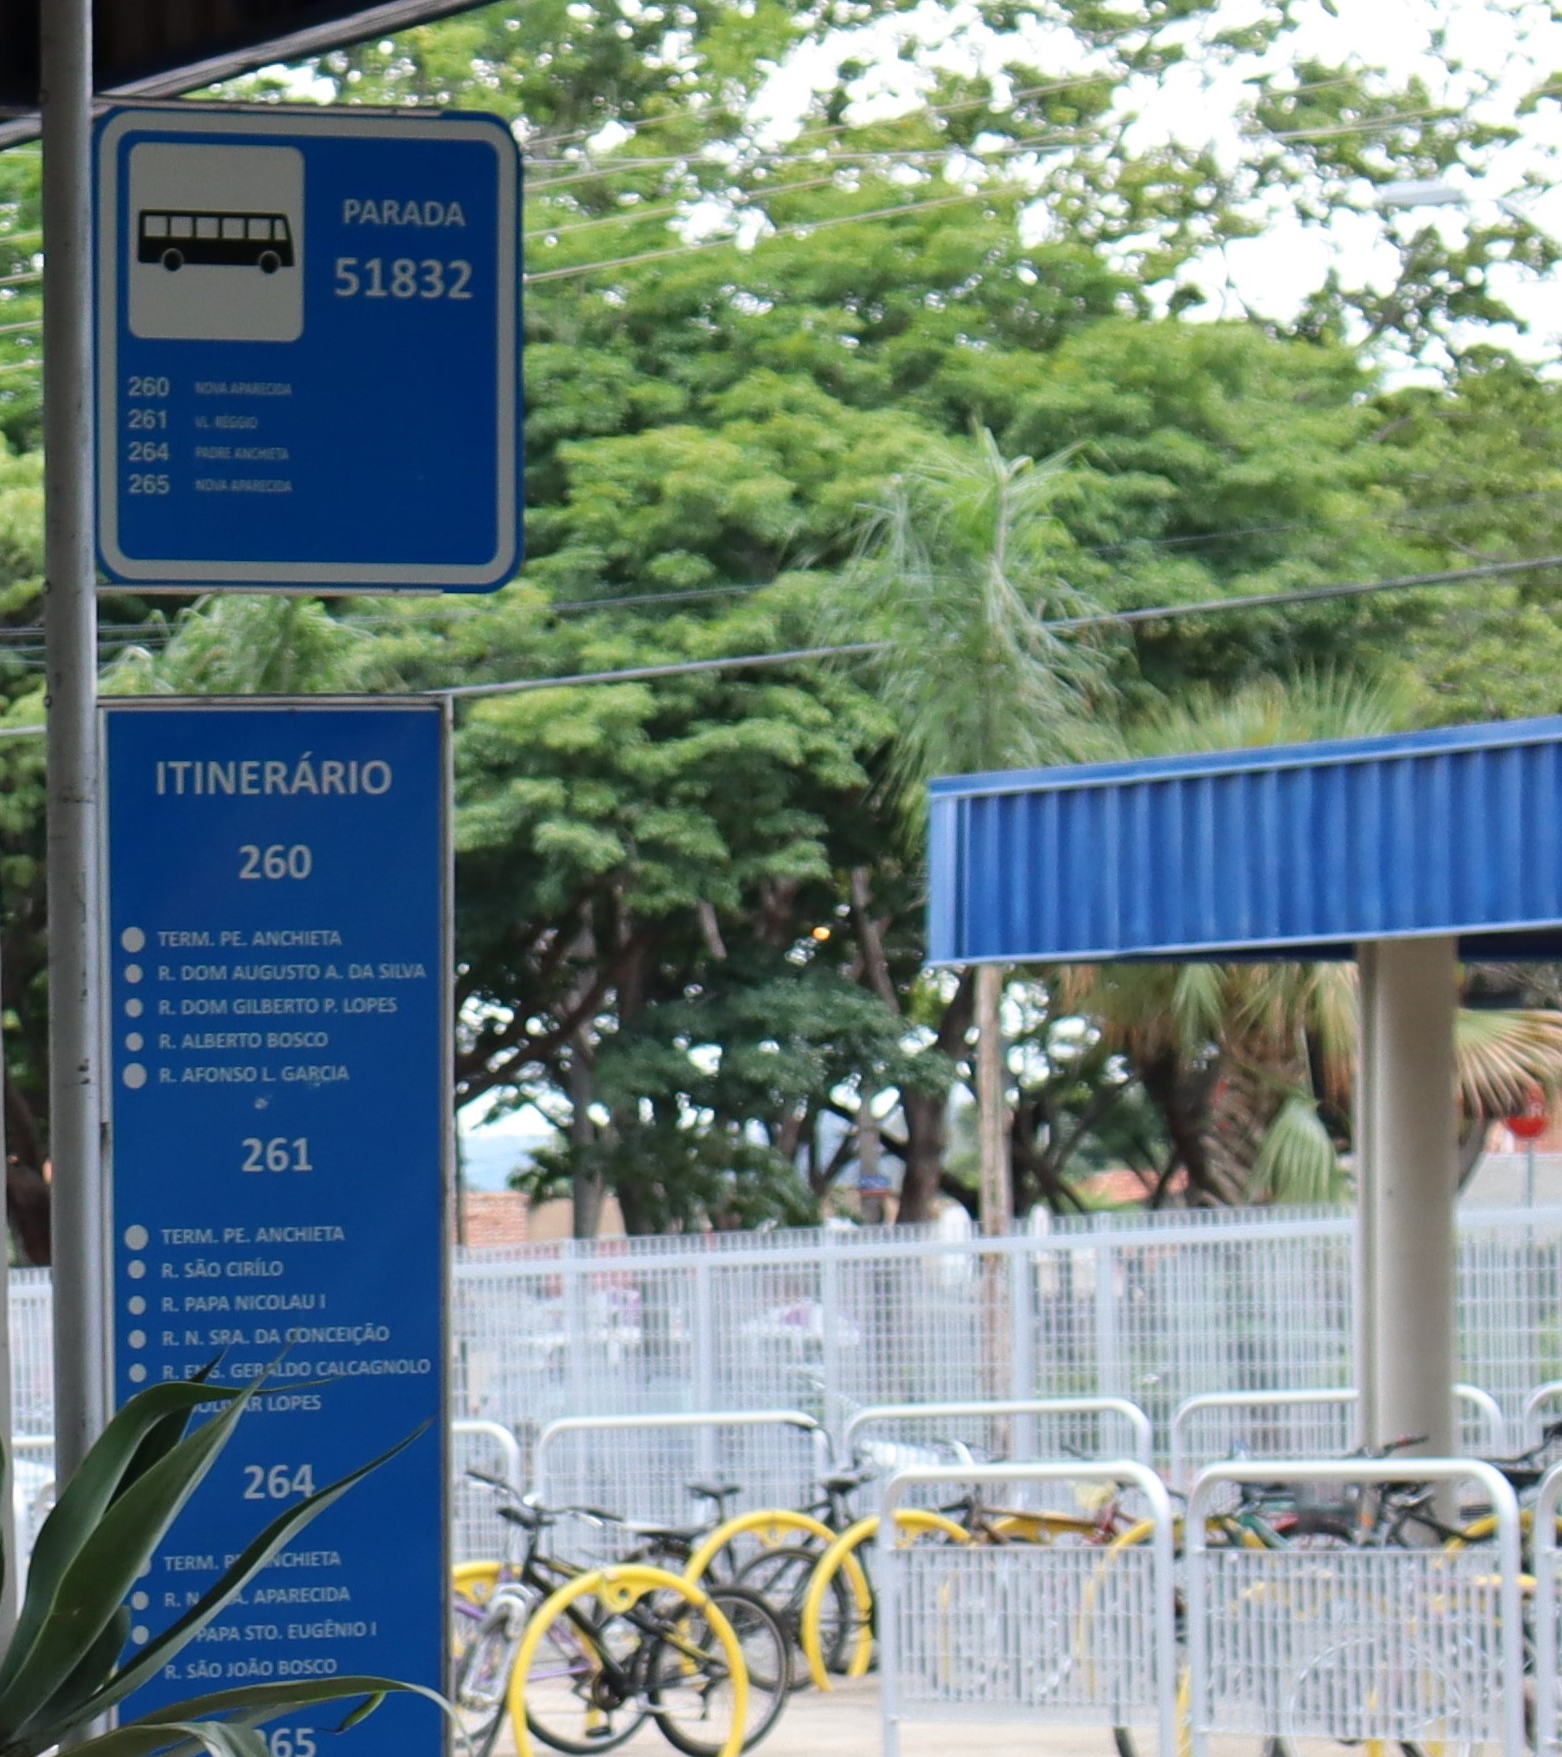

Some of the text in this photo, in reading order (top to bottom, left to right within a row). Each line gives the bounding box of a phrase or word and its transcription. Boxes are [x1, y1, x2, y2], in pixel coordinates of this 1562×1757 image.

[342, 198, 466, 228] PARADA
[334, 257, 473, 300] 51832
[127, 376, 170, 398] 260
[127, 408, 168, 430] 261
[127, 441, 170, 463] 264
[127, 473, 170, 496] 265
[155, 751, 393, 796] ITINERÁRIO
[238, 843, 312, 880] 260
[158, 930, 342, 947] TERM. PE. ANCHIETA
[158, 963, 425, 981] R. DOM AUGUSTO A. DA SILVA
[158, 997, 398, 1015] R. DOM GILBERTO P. LOPES
[158, 1032, 329, 1049] R. ALBERTO BOSCO
[158, 1067, 176, 1083] R.
[181, 1066, 257, 1082] AFONSO
[282, 1064, 349, 1082] GARCIA
[241, 1137, 312, 1172] 261
[162, 1225, 345, 1245] TERM. PE. ANCHIETA
[161, 1257, 284, 1278] R. SÃO CIRÍLO
[161, 1296, 179, 1312] R.
[184, 1295, 229, 1311] PAPA
[235, 1293, 315, 1310] NICOLAU
[162, 1322, 390, 1346] R. N. SRA. DA CONCEIÇÃO
[162, 1364, 179, 1380] R.
[316, 1358, 431, 1377] CALCAGNOLO
[268, 1395, 321, 1411] LOPES
[243, 1464, 315, 1500] 264
[164, 1555, 218, 1571] TERM.
[264, 1551, 341, 1568] NCHIETA
[165, 1593, 181, 1607] R.
[254, 1586, 350, 1604] APARECIDA
[196, 1626, 240, 1642] PAPA
[245, 1625, 282, 1640] STO.
[288, 1620, 366, 1639] EUGÊNIO
[165, 1658, 338, 1679] R. SÃO JOÃO BOSCO
